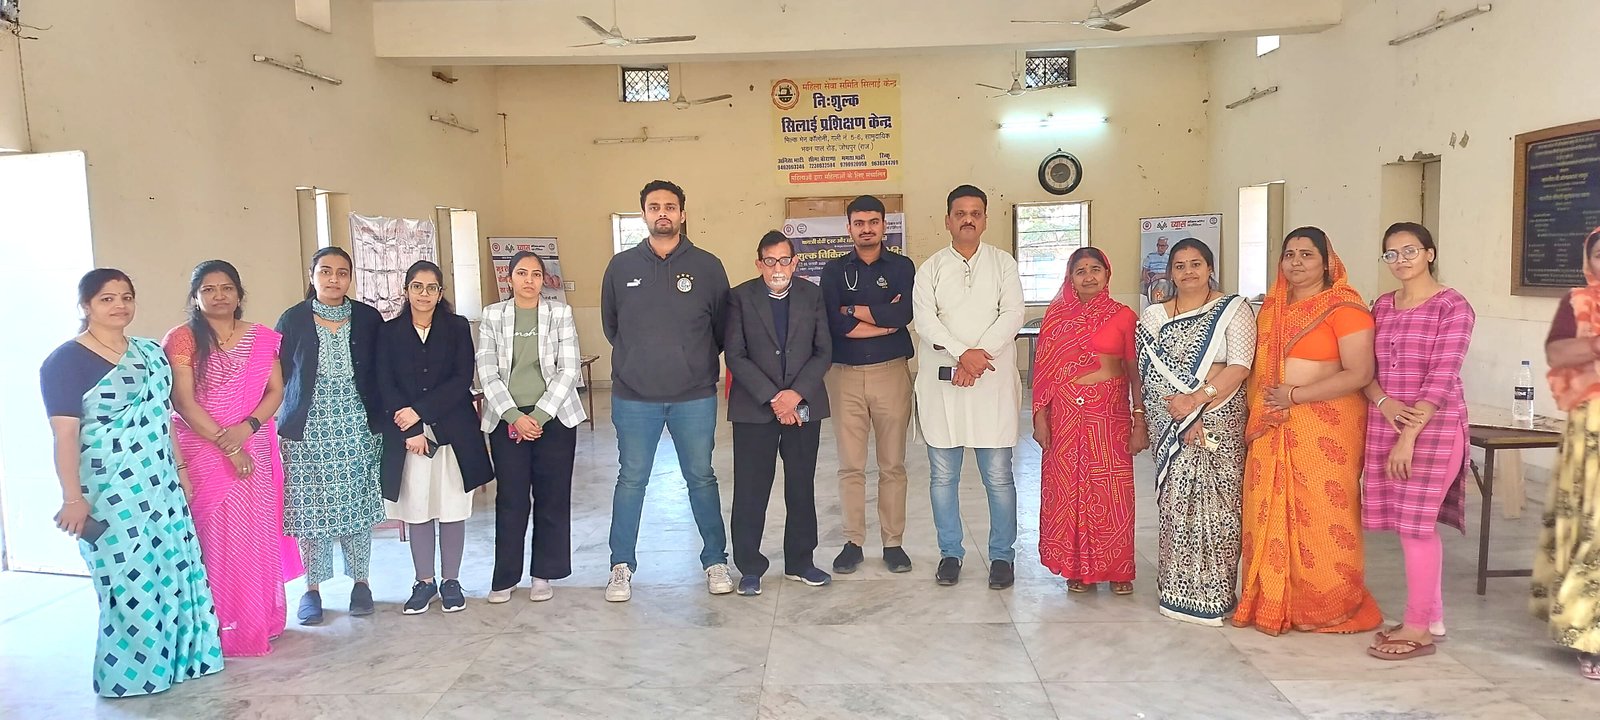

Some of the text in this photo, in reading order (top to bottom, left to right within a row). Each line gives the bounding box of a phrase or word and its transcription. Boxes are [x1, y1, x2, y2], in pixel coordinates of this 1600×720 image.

[802, 83, 821, 91] महिला
[824, 81, 837, 90] सेवा
[839, 80, 858, 89] समिति
[861, 78, 881, 89] सिलाई
[781, 113, 892, 133] सिलाई प्रशिक्षण केन्द्र
